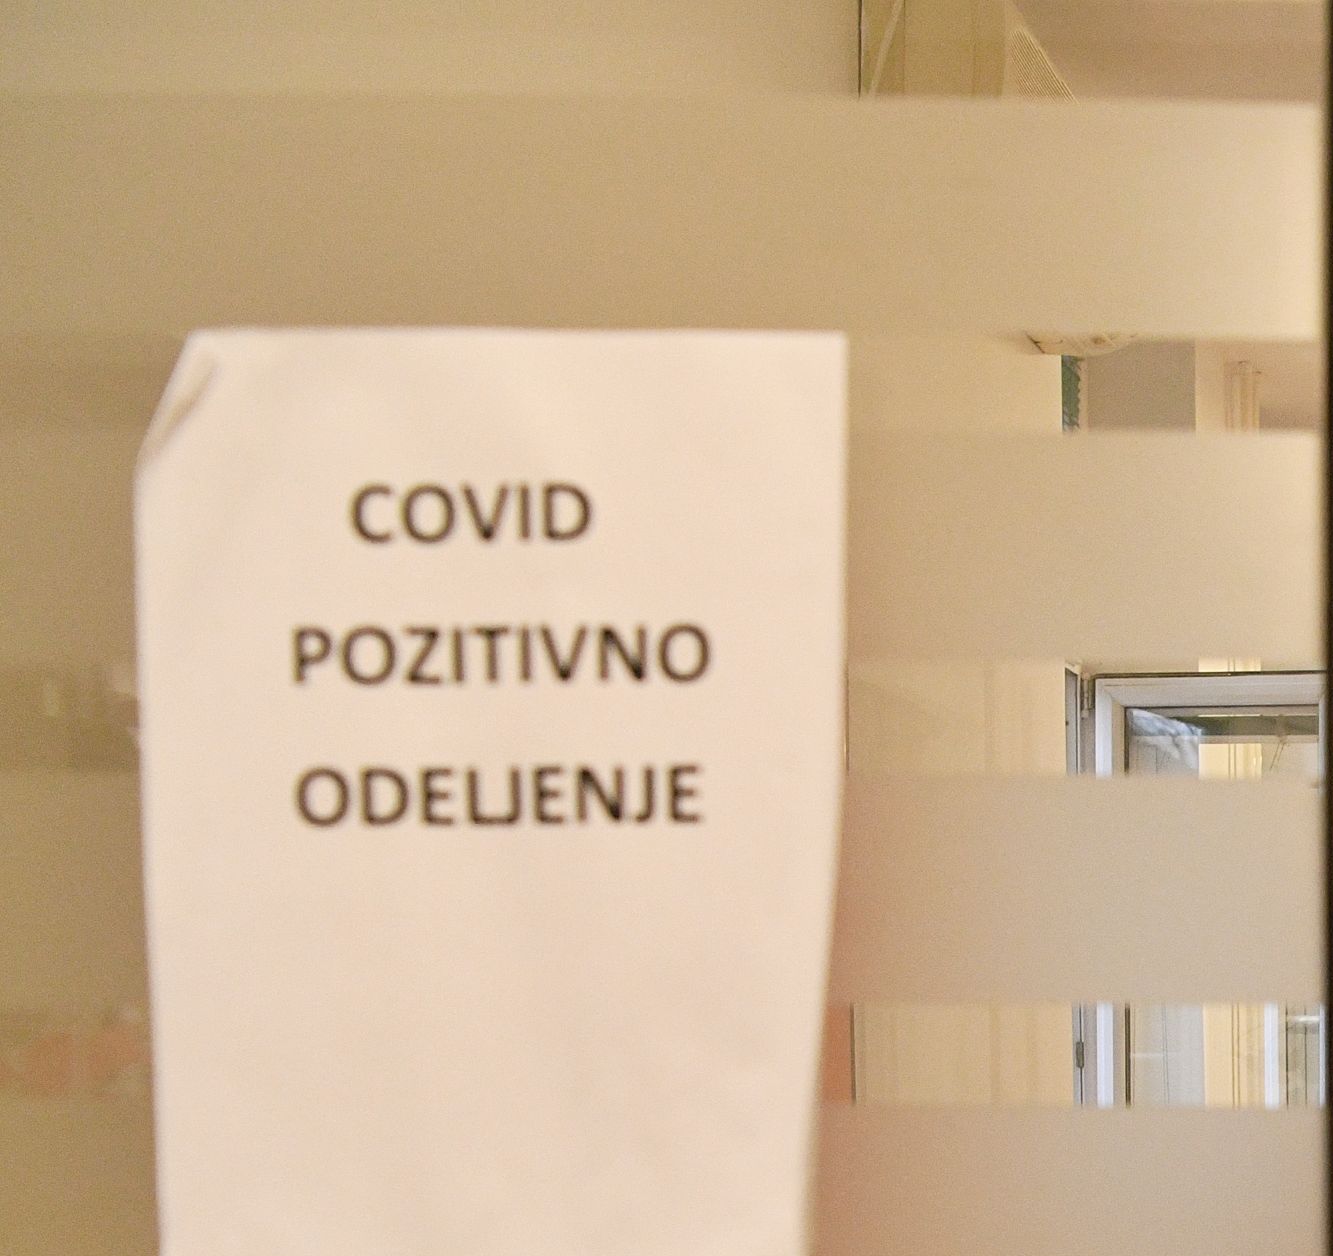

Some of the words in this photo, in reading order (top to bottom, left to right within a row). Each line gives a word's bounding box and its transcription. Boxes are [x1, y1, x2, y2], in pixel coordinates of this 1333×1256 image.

[350, 482, 592, 544] COVID
[292, 623, 711, 686] POZITIVNO
[294, 763, 704, 827] ODELJENJE
